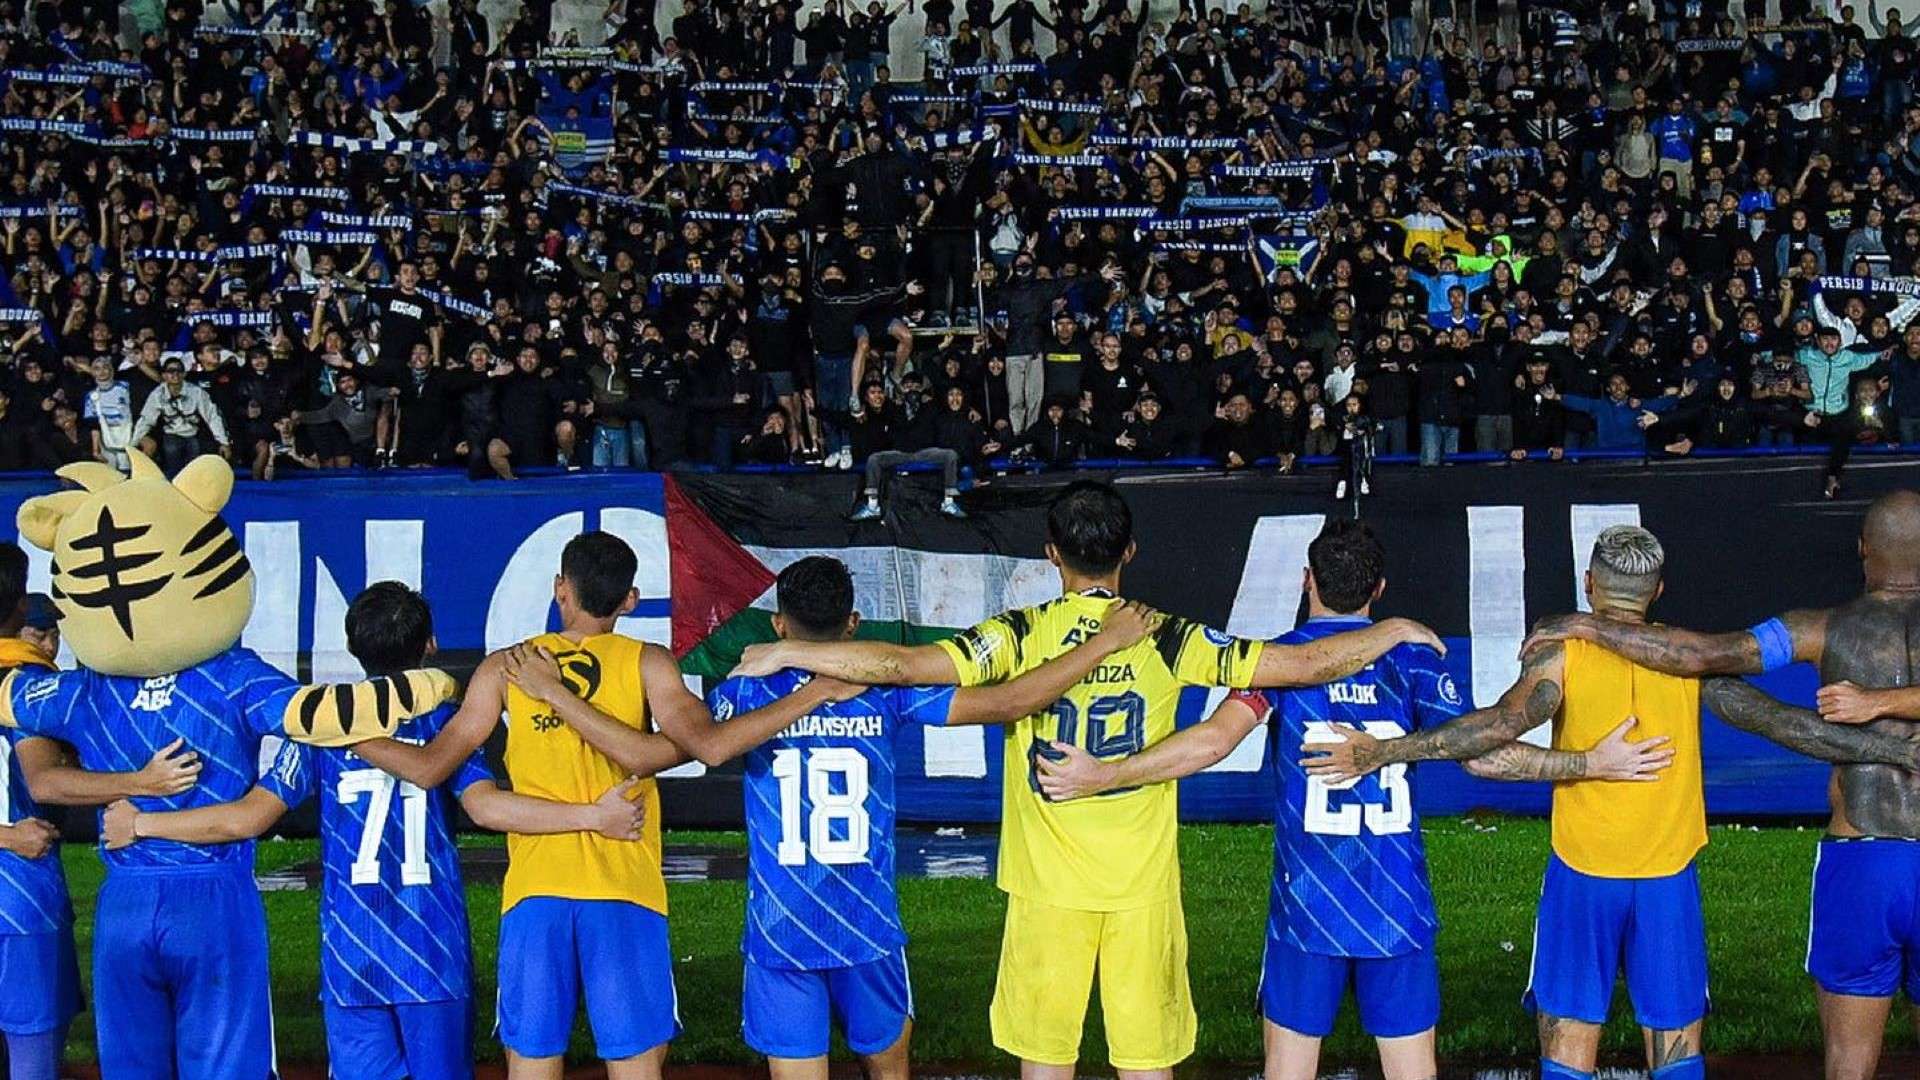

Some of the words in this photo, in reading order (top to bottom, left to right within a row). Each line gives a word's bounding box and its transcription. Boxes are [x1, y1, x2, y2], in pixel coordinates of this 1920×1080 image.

[1820, 276, 1864, 290] PERSIB
[1328, 683, 1378, 704] KLOK
[337, 768, 432, 886] 71
[772, 747, 873, 866] 18
[1302, 721, 1413, 836] 23
